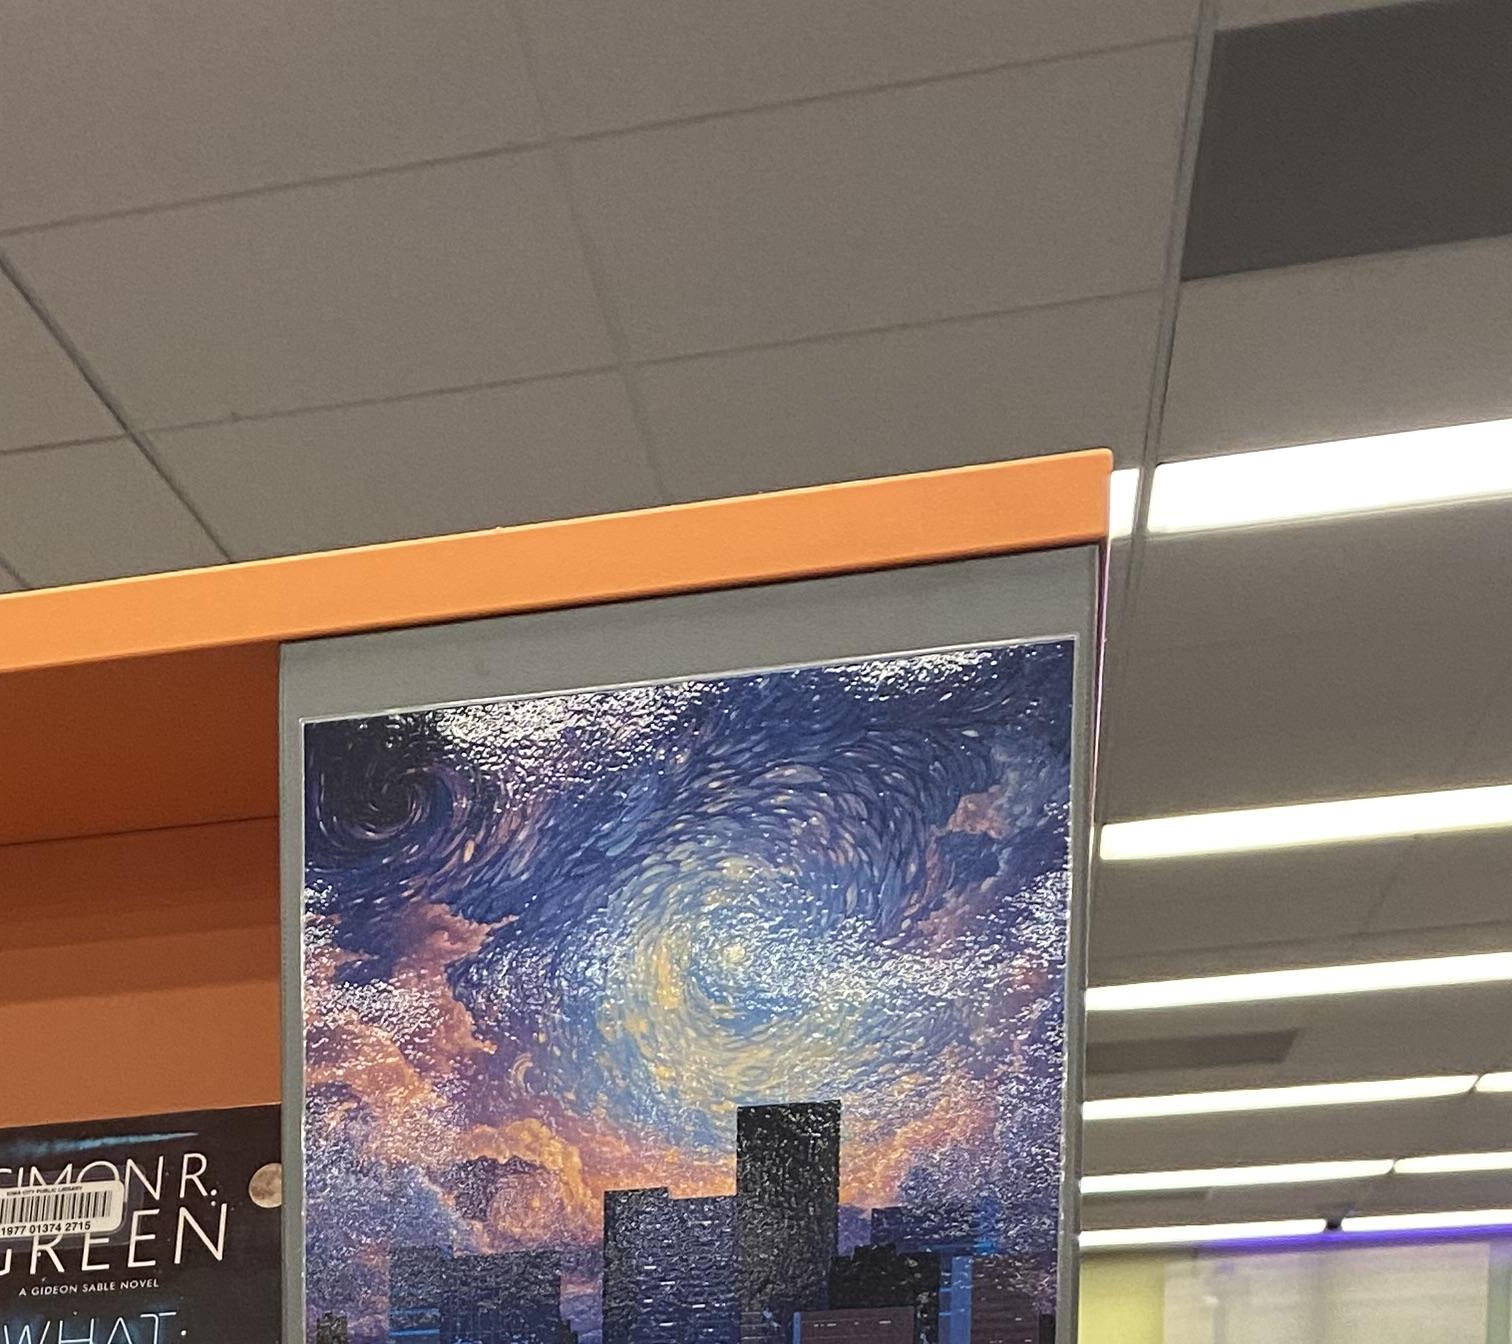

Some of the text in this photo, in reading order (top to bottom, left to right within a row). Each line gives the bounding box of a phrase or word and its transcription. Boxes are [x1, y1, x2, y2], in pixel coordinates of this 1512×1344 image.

[179, 1152, 218, 1198] R.
[1, 1225, 27, 1235] 1977
[29, 1223, 62, 1234] 01374
[65, 1221, 91, 1232] 2715
[18, 1278, 160, 1297] A GIDEON SABLE NOVEL
